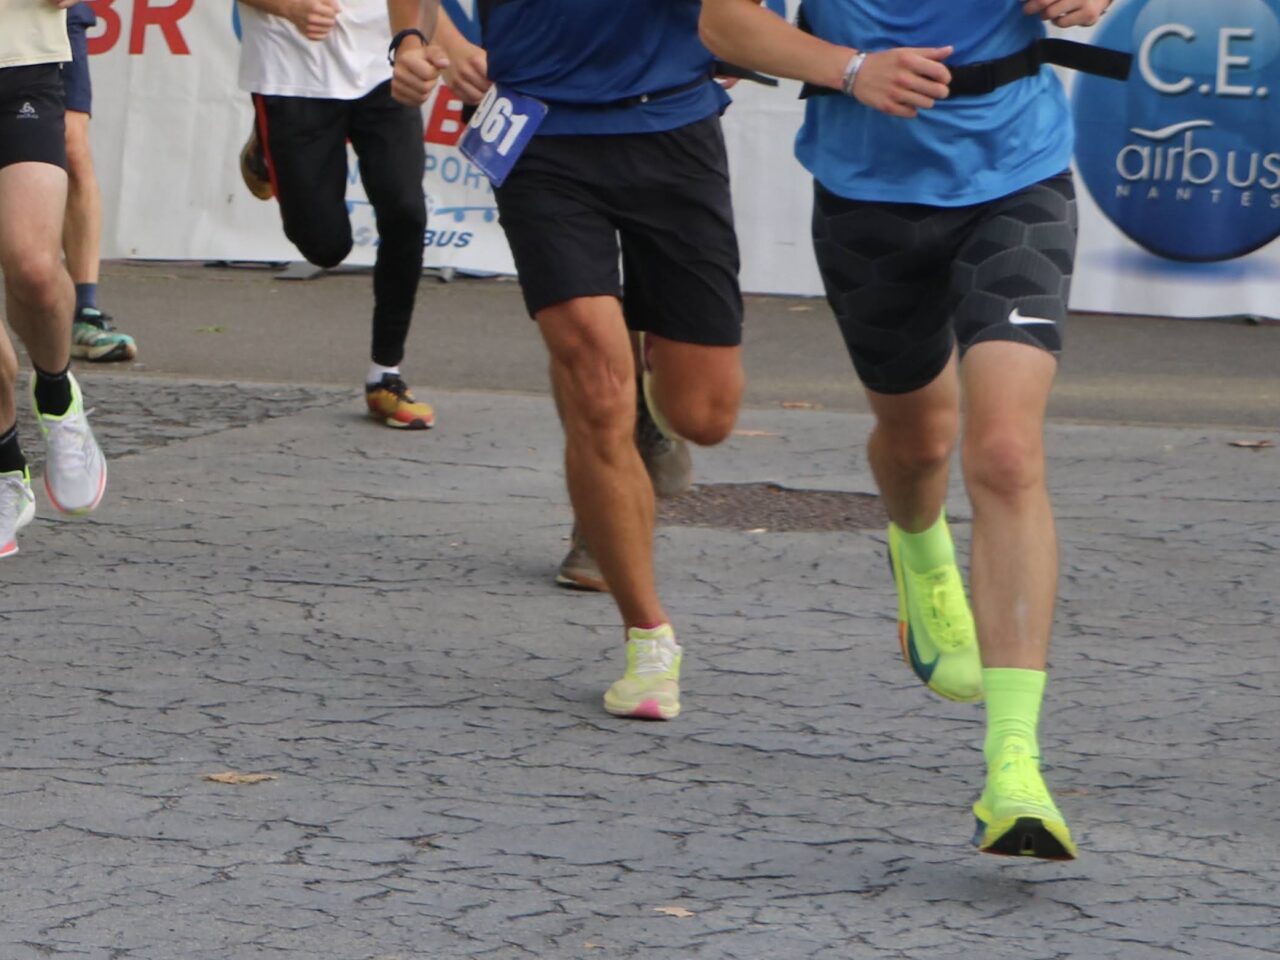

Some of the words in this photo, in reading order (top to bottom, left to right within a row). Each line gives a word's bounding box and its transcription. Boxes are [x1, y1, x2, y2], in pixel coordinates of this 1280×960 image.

[1138, 23, 1269, 95] C.E.
[1115, 130, 1280, 190] airbus
[1115, 184, 1280, 209] NANTES
